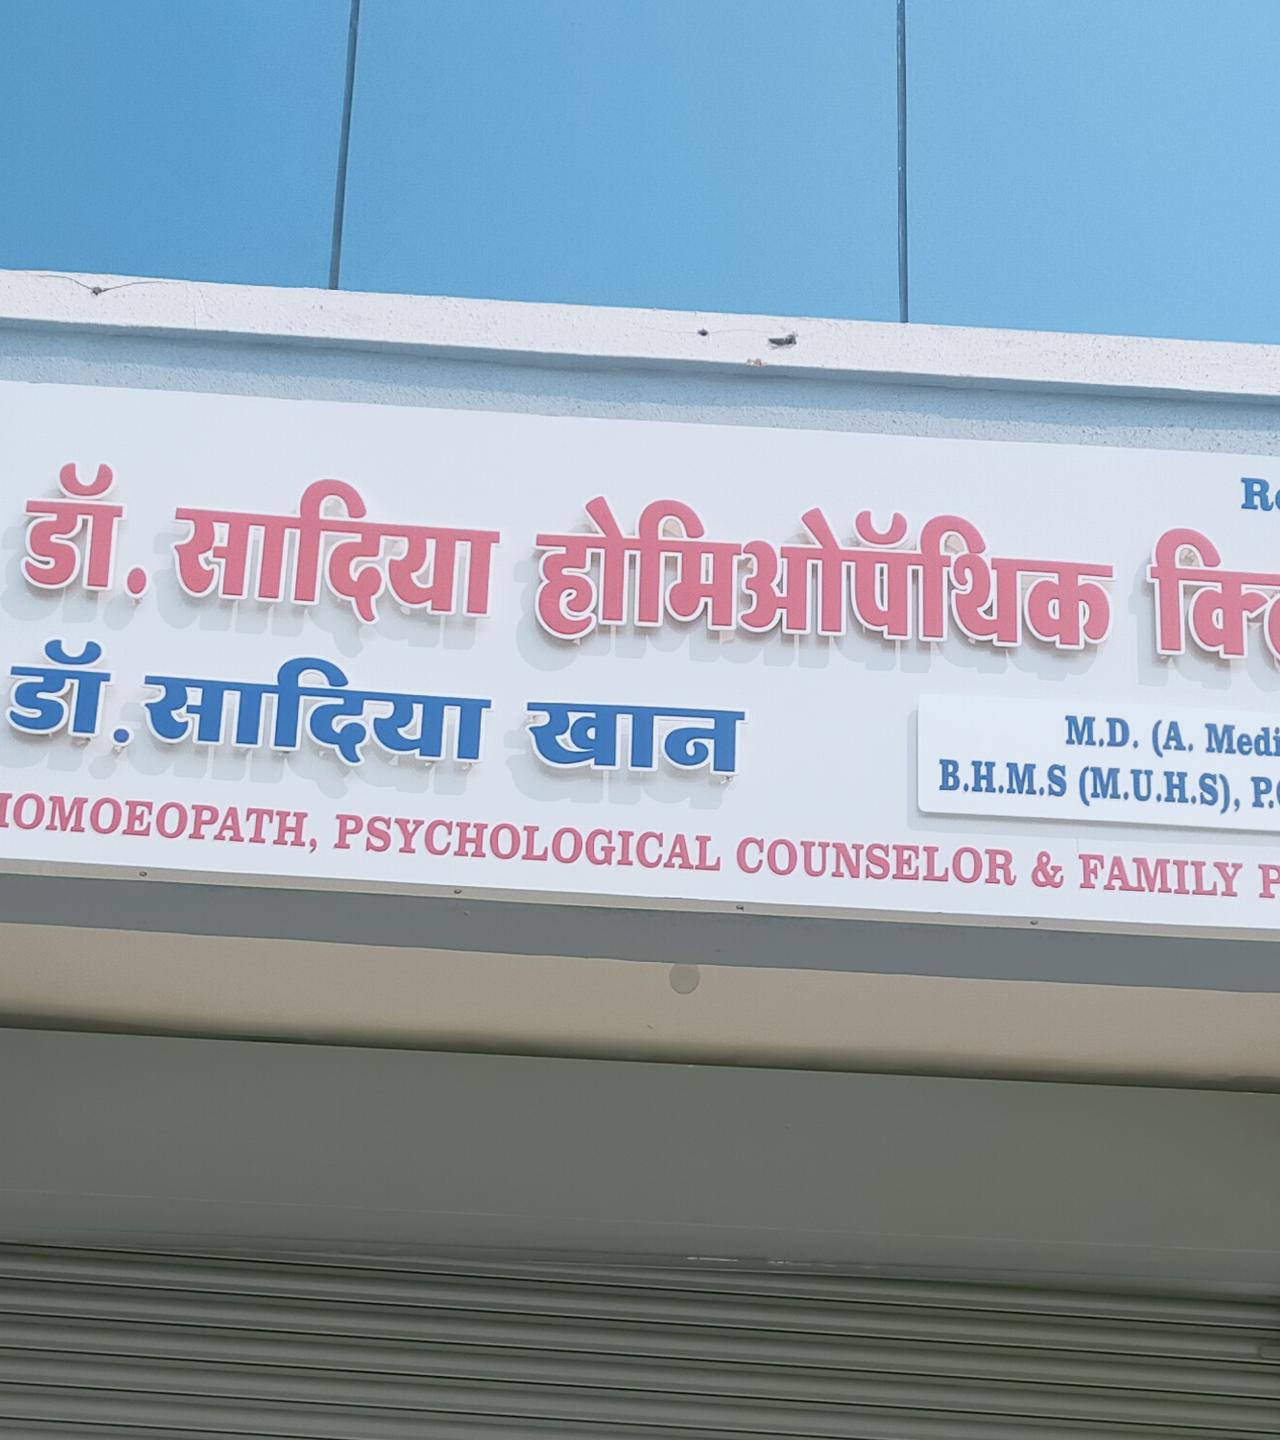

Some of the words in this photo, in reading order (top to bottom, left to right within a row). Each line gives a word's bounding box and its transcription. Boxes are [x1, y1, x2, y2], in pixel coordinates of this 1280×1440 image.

[174, 479, 500, 623] सादिया
[526, 702, 746, 773] खान
[1065, 715, 1139, 748] M.D.
[939, 758, 1068, 797] B.H.M.S
[334, 814, 721, 872] PSYCHOLOGICAL
[736, 837, 1017, 887] COUNSELOR
[1031, 850, 1064, 889] &
[1078, 853, 1244, 898] FAMILY
